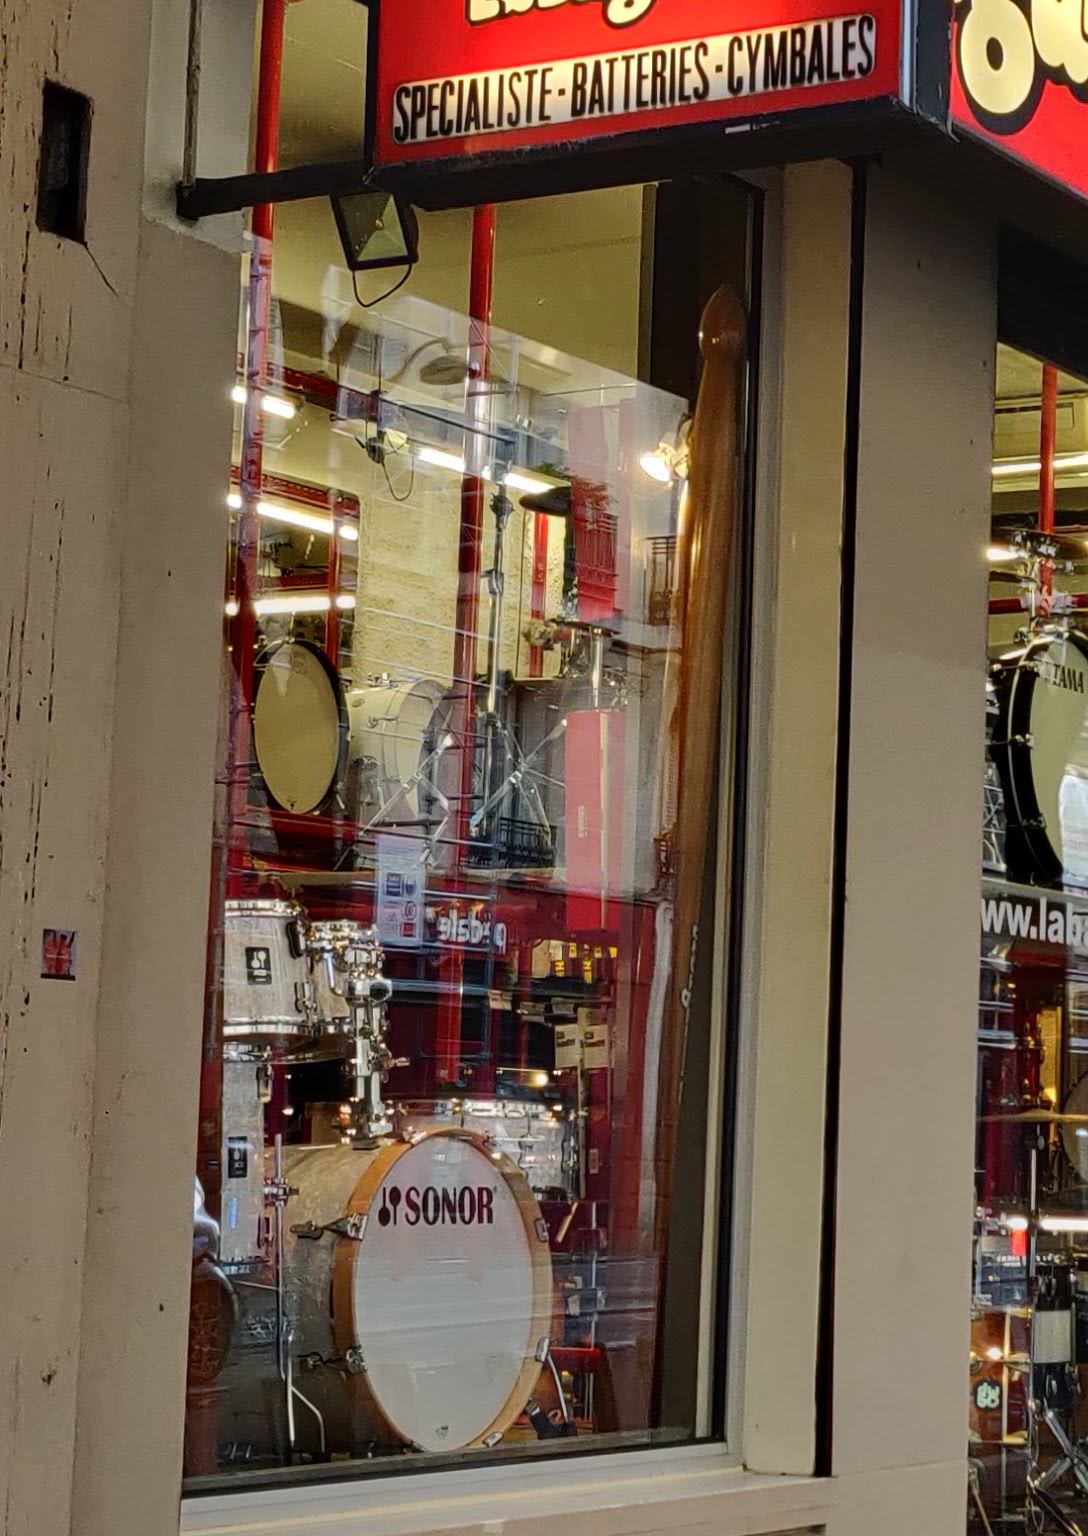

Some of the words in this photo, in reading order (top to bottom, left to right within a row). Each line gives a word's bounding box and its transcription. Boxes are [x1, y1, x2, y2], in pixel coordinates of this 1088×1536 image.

[393, 67, 553, 143] SPECIALISTE
[570, 40, 710, 119] BATTERIES
[727, 13, 874, 98] CYMBALES
[1053, 663, 1084, 694] TAMA
[404, 1185, 494, 1226] SONOR
